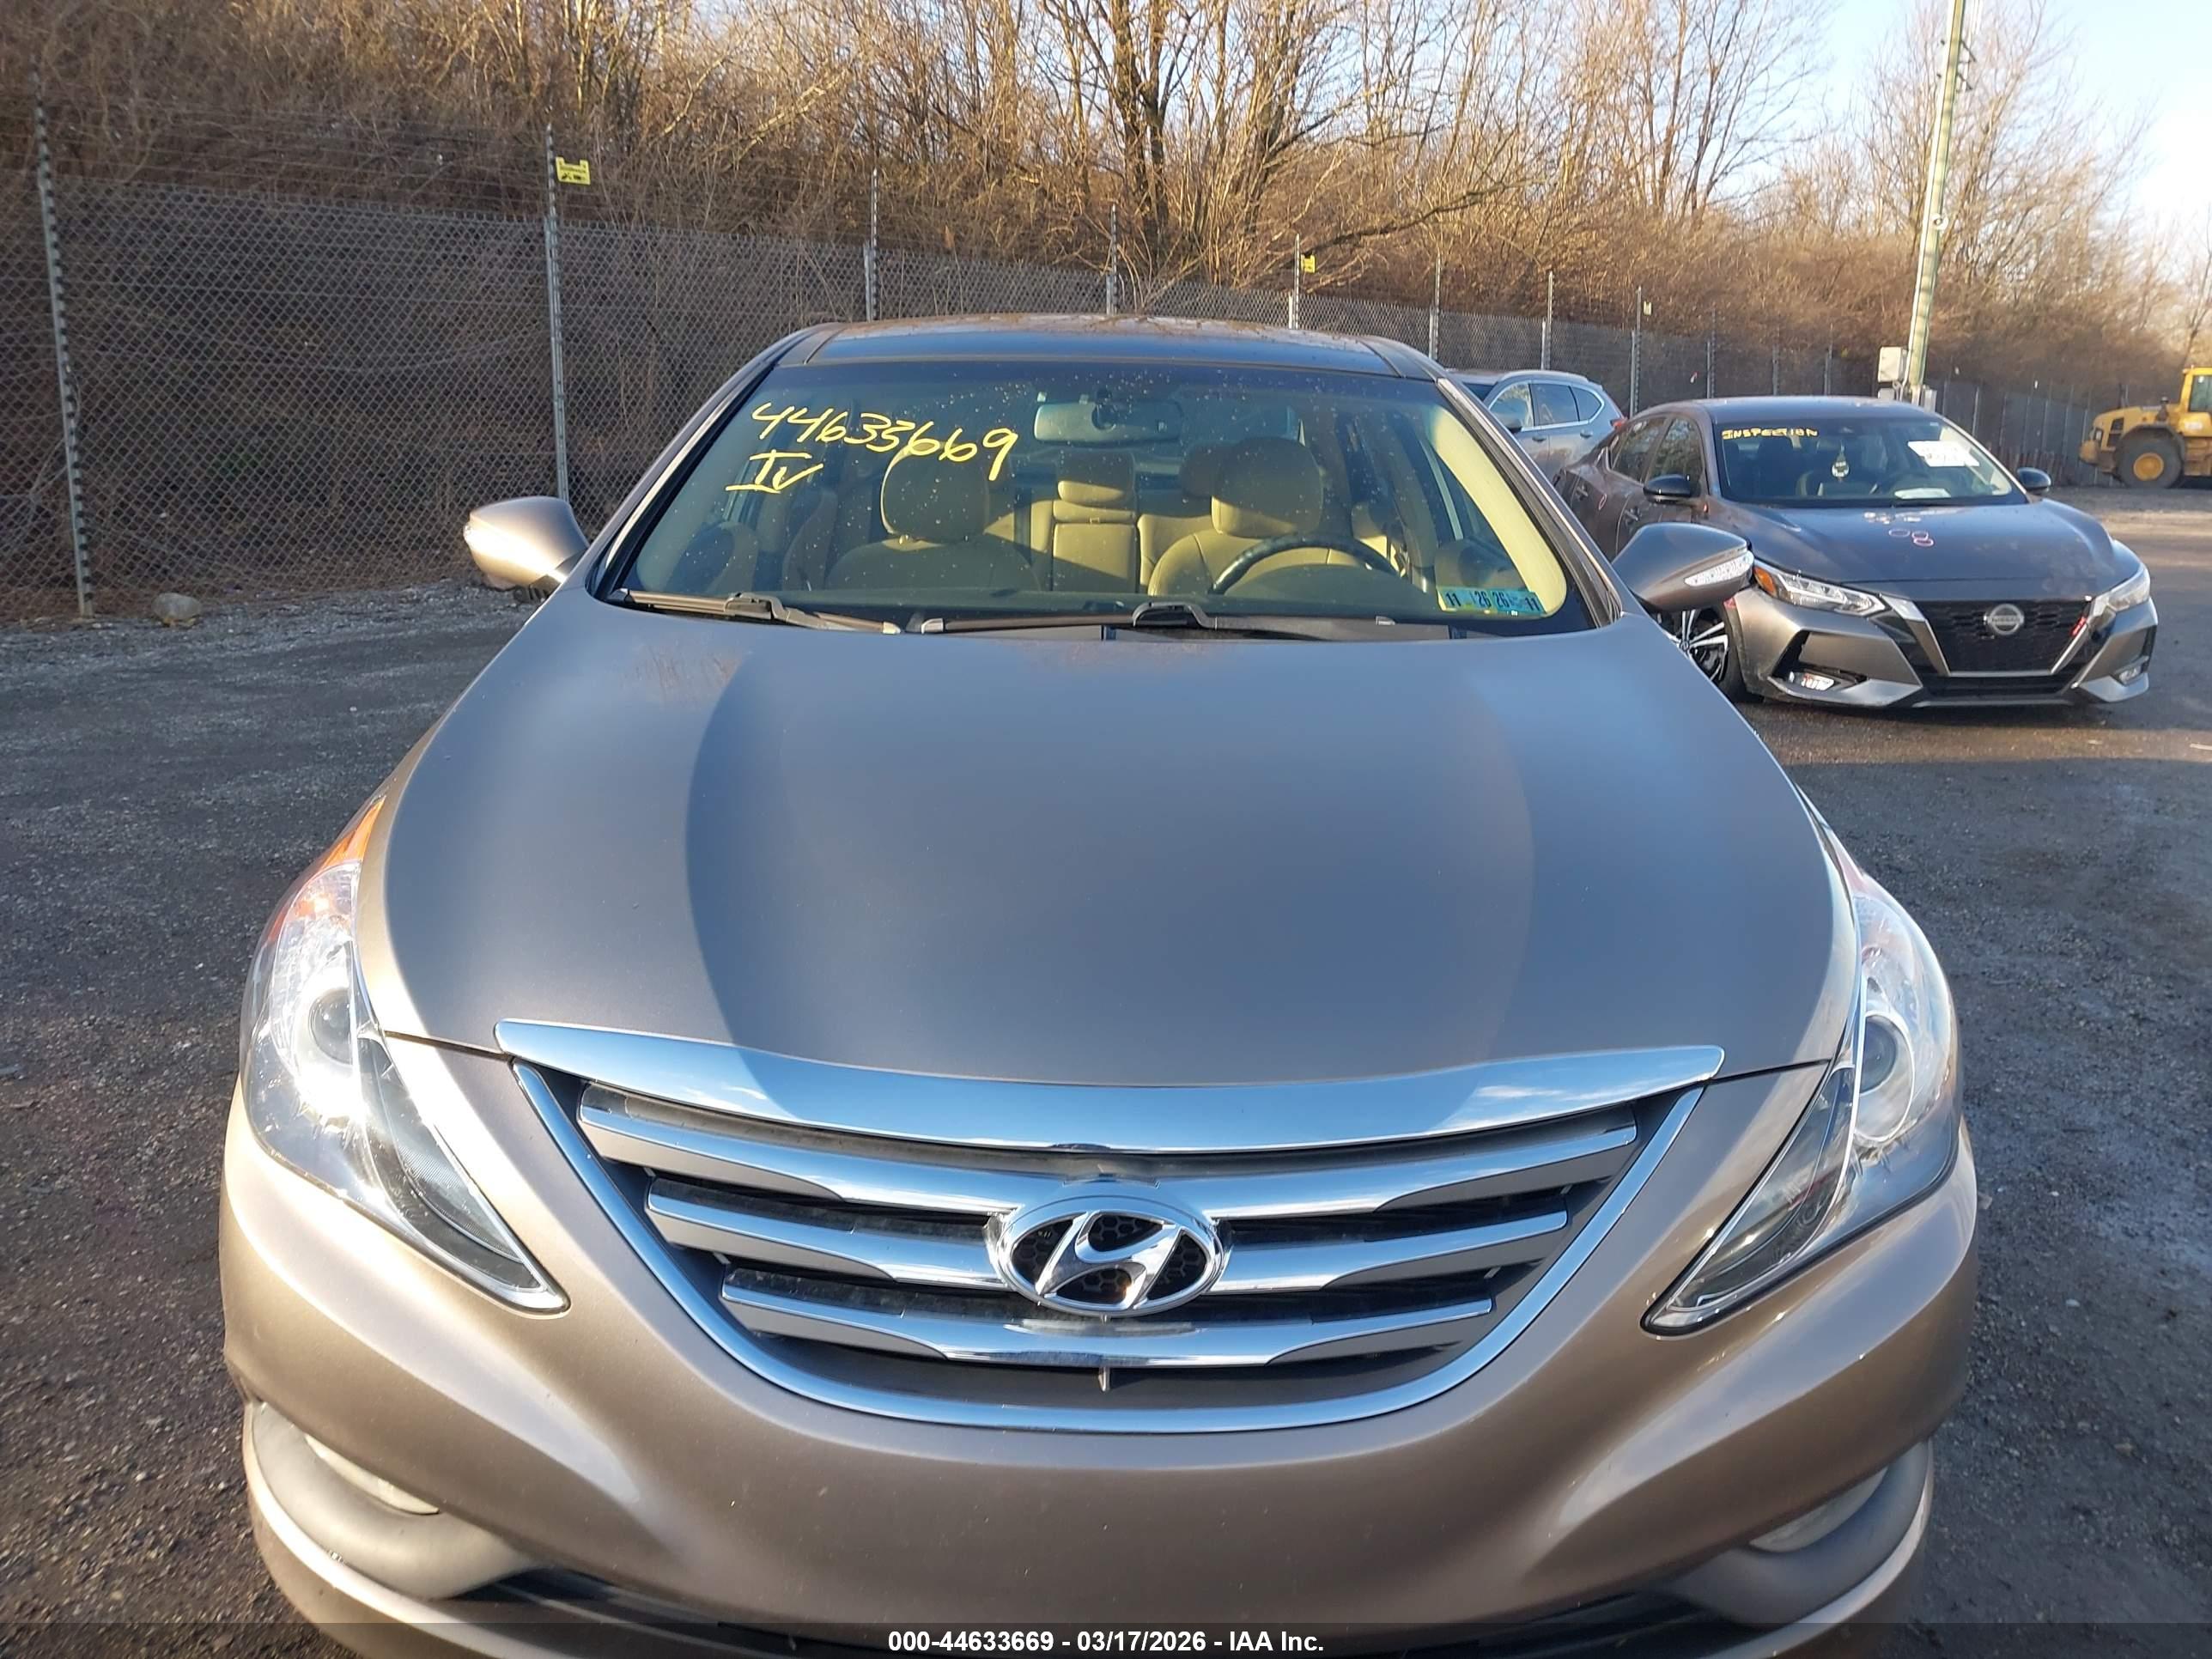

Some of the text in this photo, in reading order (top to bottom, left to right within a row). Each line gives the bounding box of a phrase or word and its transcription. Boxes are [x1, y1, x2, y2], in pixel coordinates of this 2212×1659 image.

[751, 402, 1018, 481] 44633669
[1445, 591, 1462, 607] 11
[1524, 596, 1540, 611] 11
